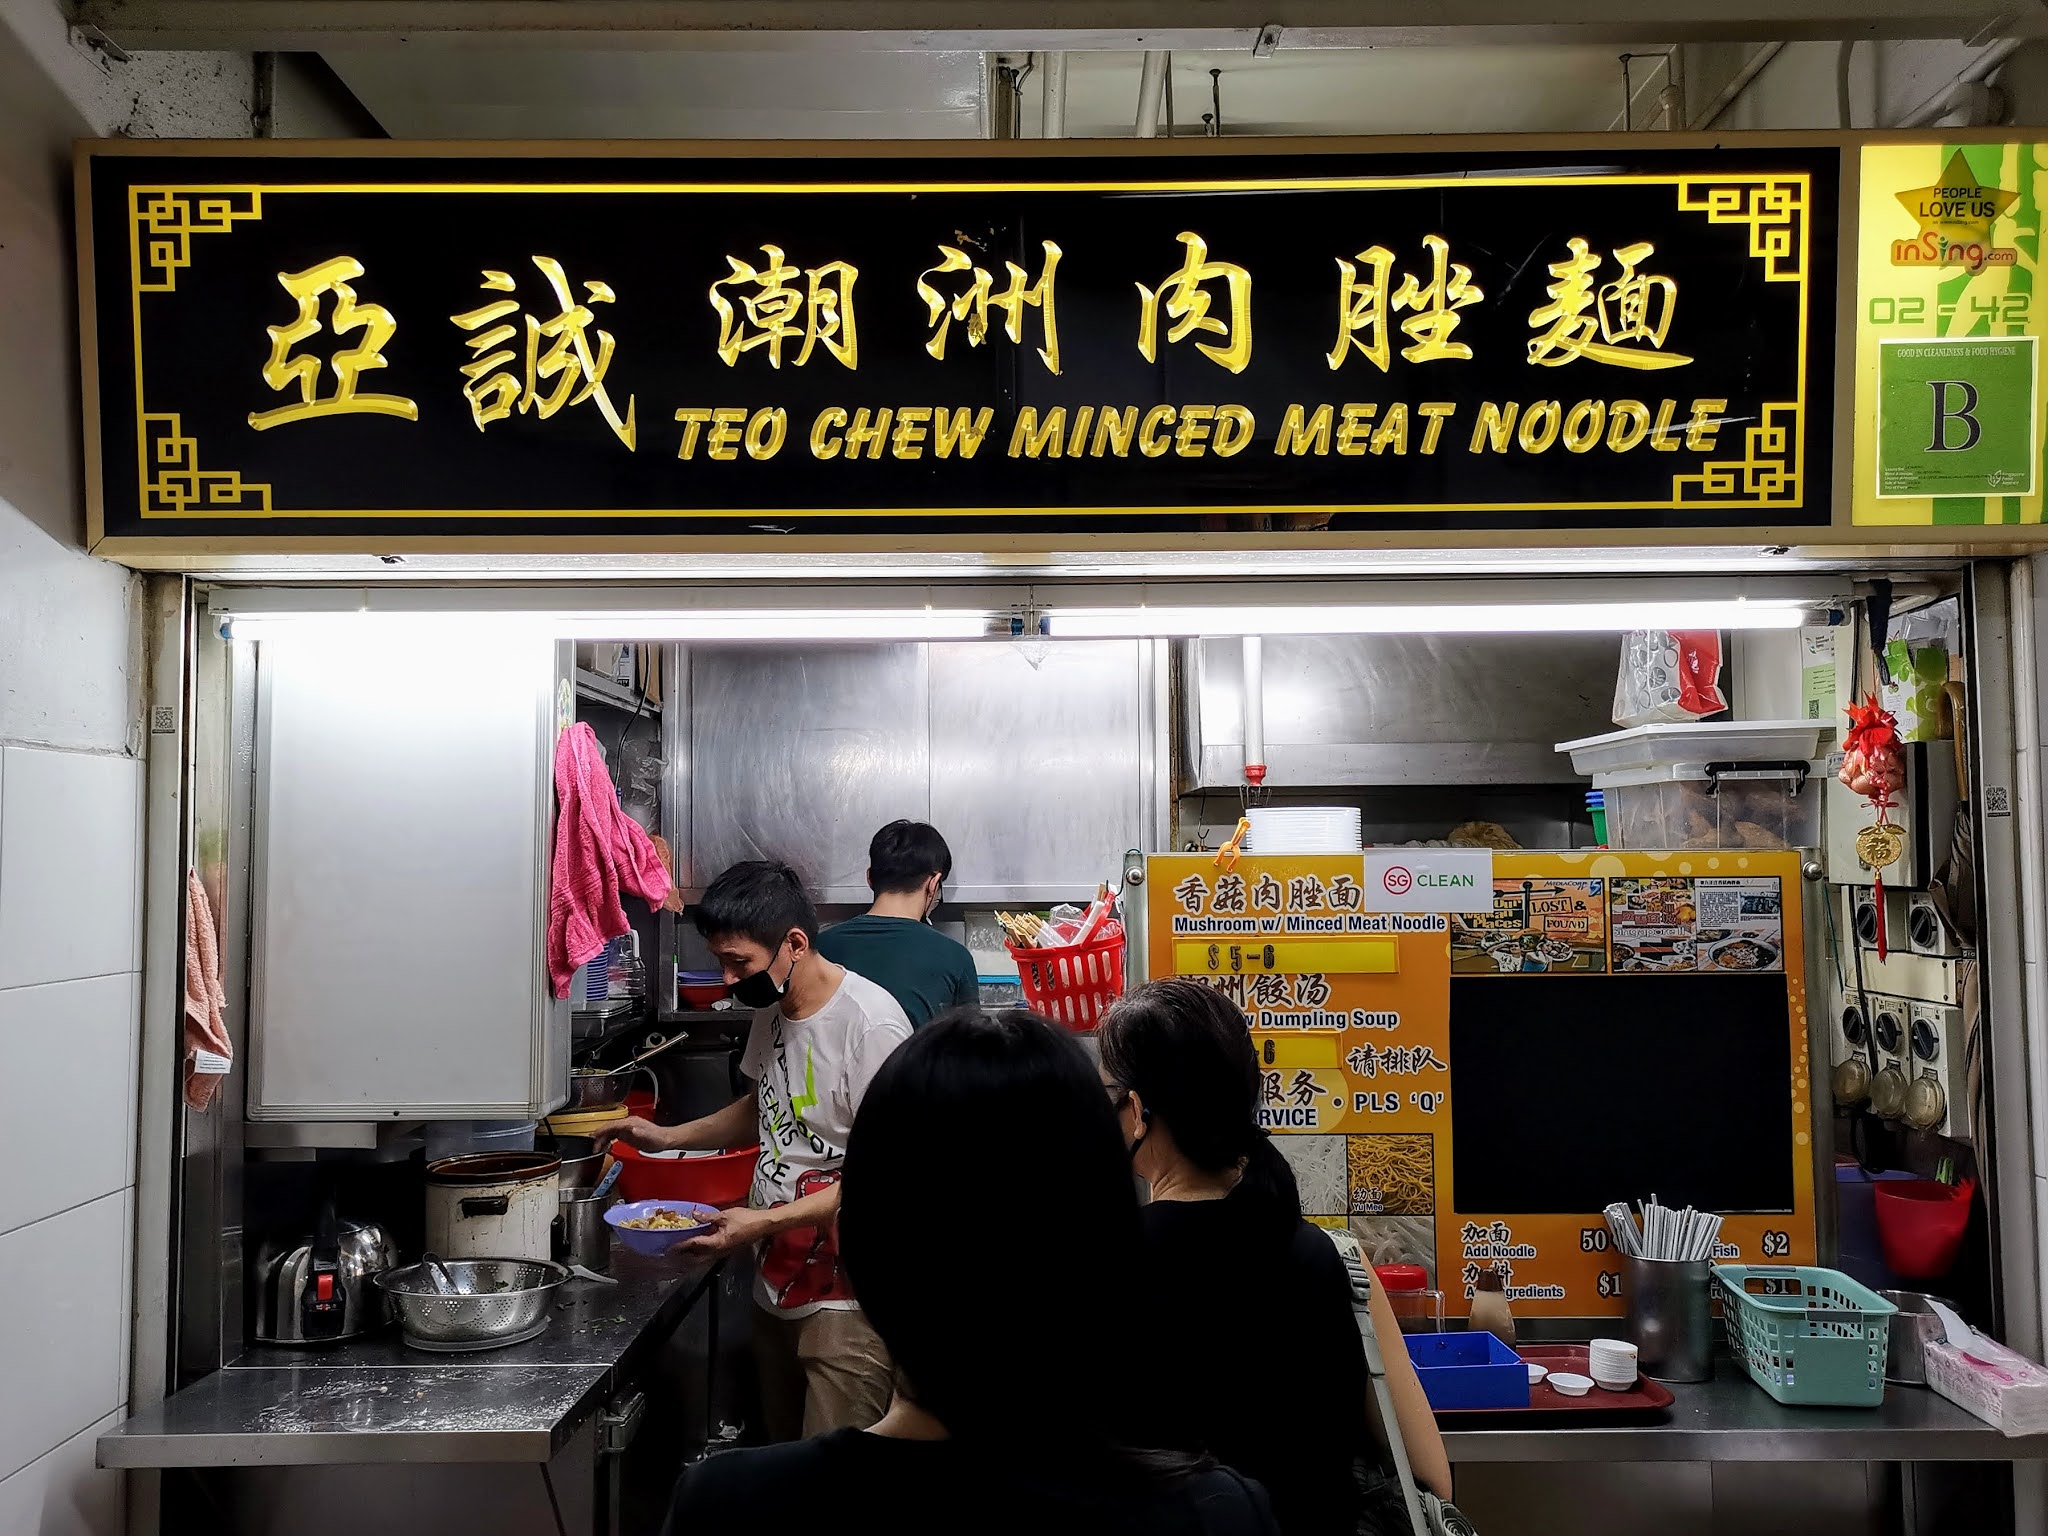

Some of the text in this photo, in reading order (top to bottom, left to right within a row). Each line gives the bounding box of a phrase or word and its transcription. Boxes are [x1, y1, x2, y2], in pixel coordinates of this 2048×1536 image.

[1933, 187, 1982, 198] PEOPLE
[1920, 202, 1995, 217] LOVE US
[1897, 348, 1915, 358] GOOD
[1916, 348, 1923, 358] IN
[1923, 347, 1964, 357] CLEANLINESS
[1965, 347, 1971, 357] &
[1972, 346, 1988, 356] FOOD
[1923, 380, 1982, 453] B
[674, 398, 1728, 461] TEO CHEW MINCED MEAT NOODLE
[1388, 874, 1474, 887] SG CLEAN
[1531, 901, 1587, 913] LOST &
[1175, 915, 1445, 932] Mushroom w/ Minced Meat Noodle
[1473, 919, 1522, 928] Places
[1546, 919, 1585, 929] FOUND
[1262, 1012, 1346, 1029] Dumpling
[1353, 1011, 1397, 1029] Soup
[1349, 1046, 1445, 1073] 请排队
[1355, 1094, 1399, 1111] PLS
[1259, 1109, 1317, 1126] RVICE
[1354, 1203, 1364, 1211] Yu
[1462, 1223, 1509, 1242] 加面
[1465, 1245, 1535, 1258] Add Noodle
[1713, 1245, 1738, 1256] Fish
[1764, 1232, 1788, 1255] $2
[1599, 1273, 1622, 1296] $1
[1766, 1277, 1789, 1294] $1
[1506, 1286, 1563, 1300] gredients
